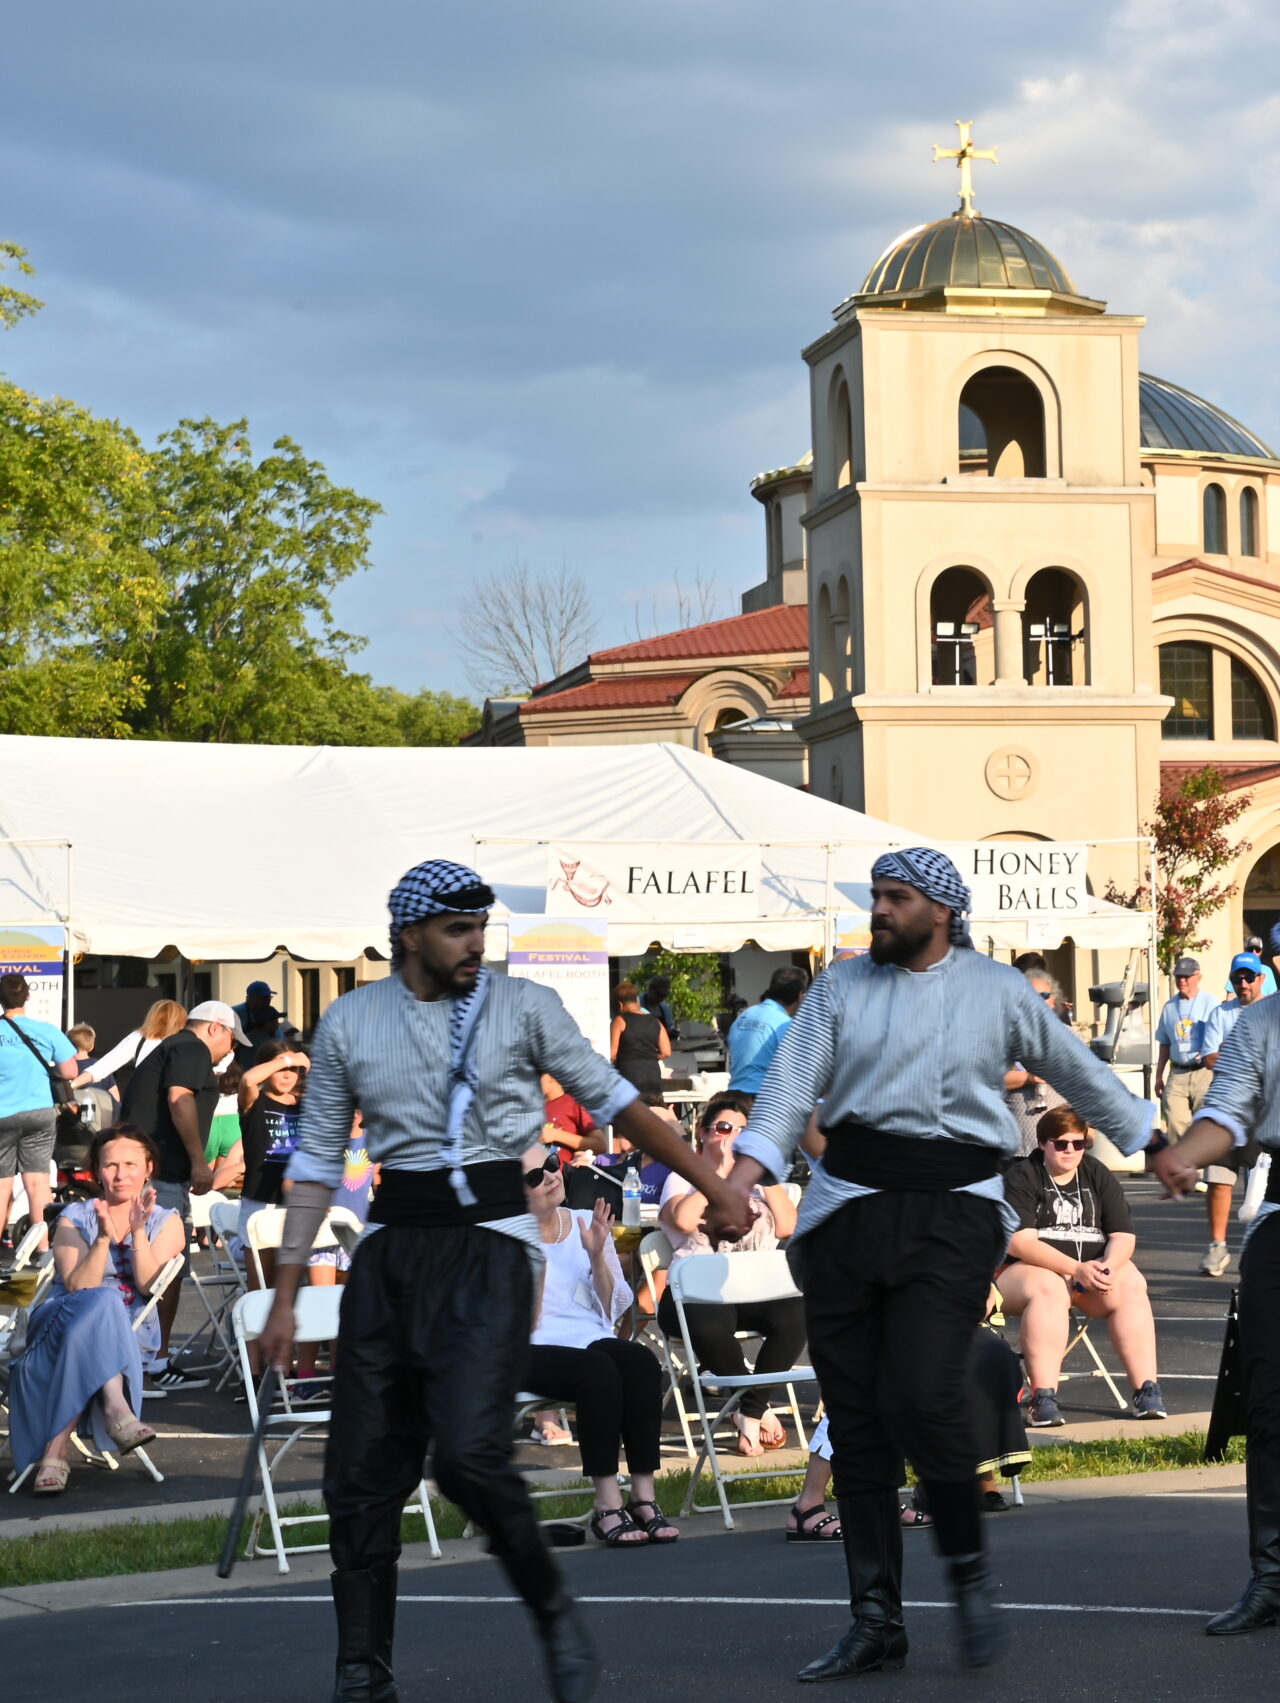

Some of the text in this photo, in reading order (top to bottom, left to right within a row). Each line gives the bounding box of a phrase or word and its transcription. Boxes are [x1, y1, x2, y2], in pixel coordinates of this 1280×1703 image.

[973, 848, 1079, 875] HONEY
[627, 866, 754, 894] FALAFEL
[998, 883, 1078, 910] BALLS
[528, 952, 591, 962] FESTIVAL
[0, 964, 42, 973] TIVAL
[512, 969, 606, 979] FALAFEL BOOTH
[28, 981, 59, 991] OTH
[268, 1129, 301, 1137] TUMB
